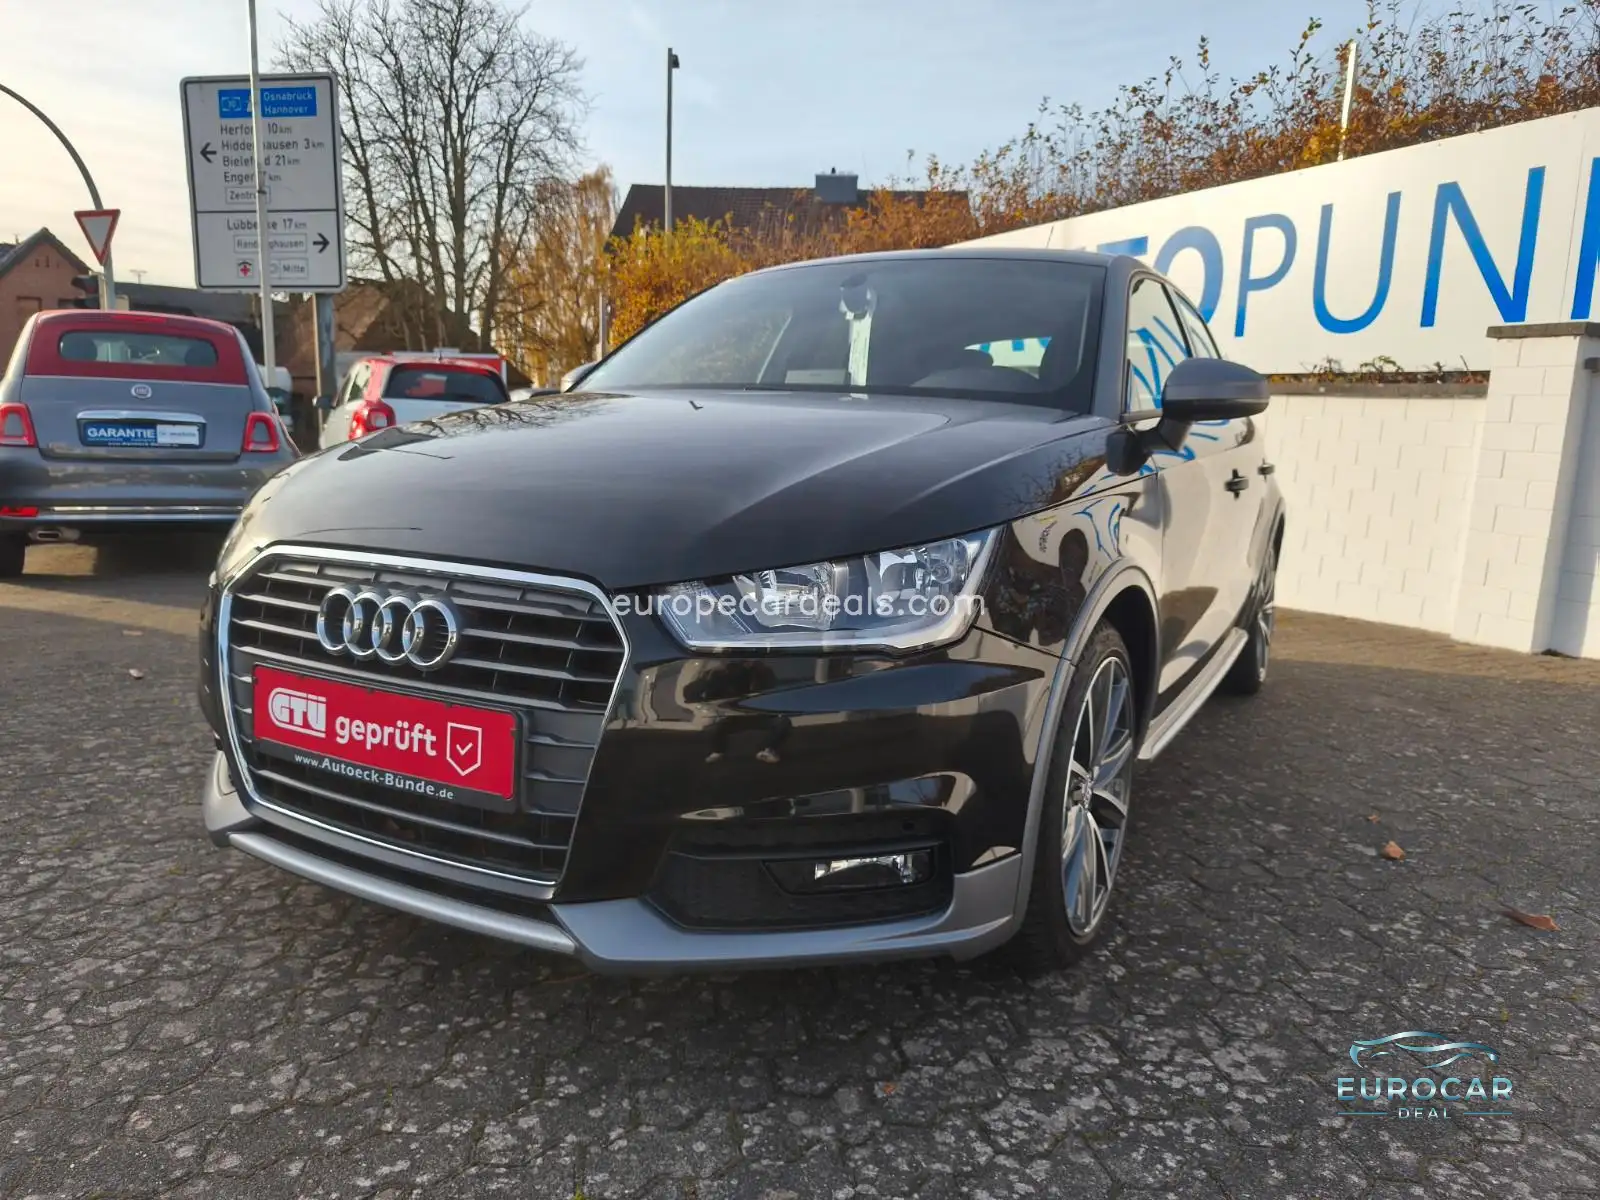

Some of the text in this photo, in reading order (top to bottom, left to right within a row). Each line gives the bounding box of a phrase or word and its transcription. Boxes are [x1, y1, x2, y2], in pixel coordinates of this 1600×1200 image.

[264, 105, 309, 115] Hannover
[220, 123, 253, 135] Herfo
[268, 122, 278, 134] 10
[221, 138, 299, 151] Hiddeausen
[223, 155, 270, 167] Bielefd
[229, 190, 258, 201] Zentru
[226, 217, 278, 231] Lübbeke
[87, 427, 156, 438] GARANTIE
[268, 687, 437, 757] GTÜ geprüft
[294, 752, 454, 800] www.Autoeck-Bünde.de
